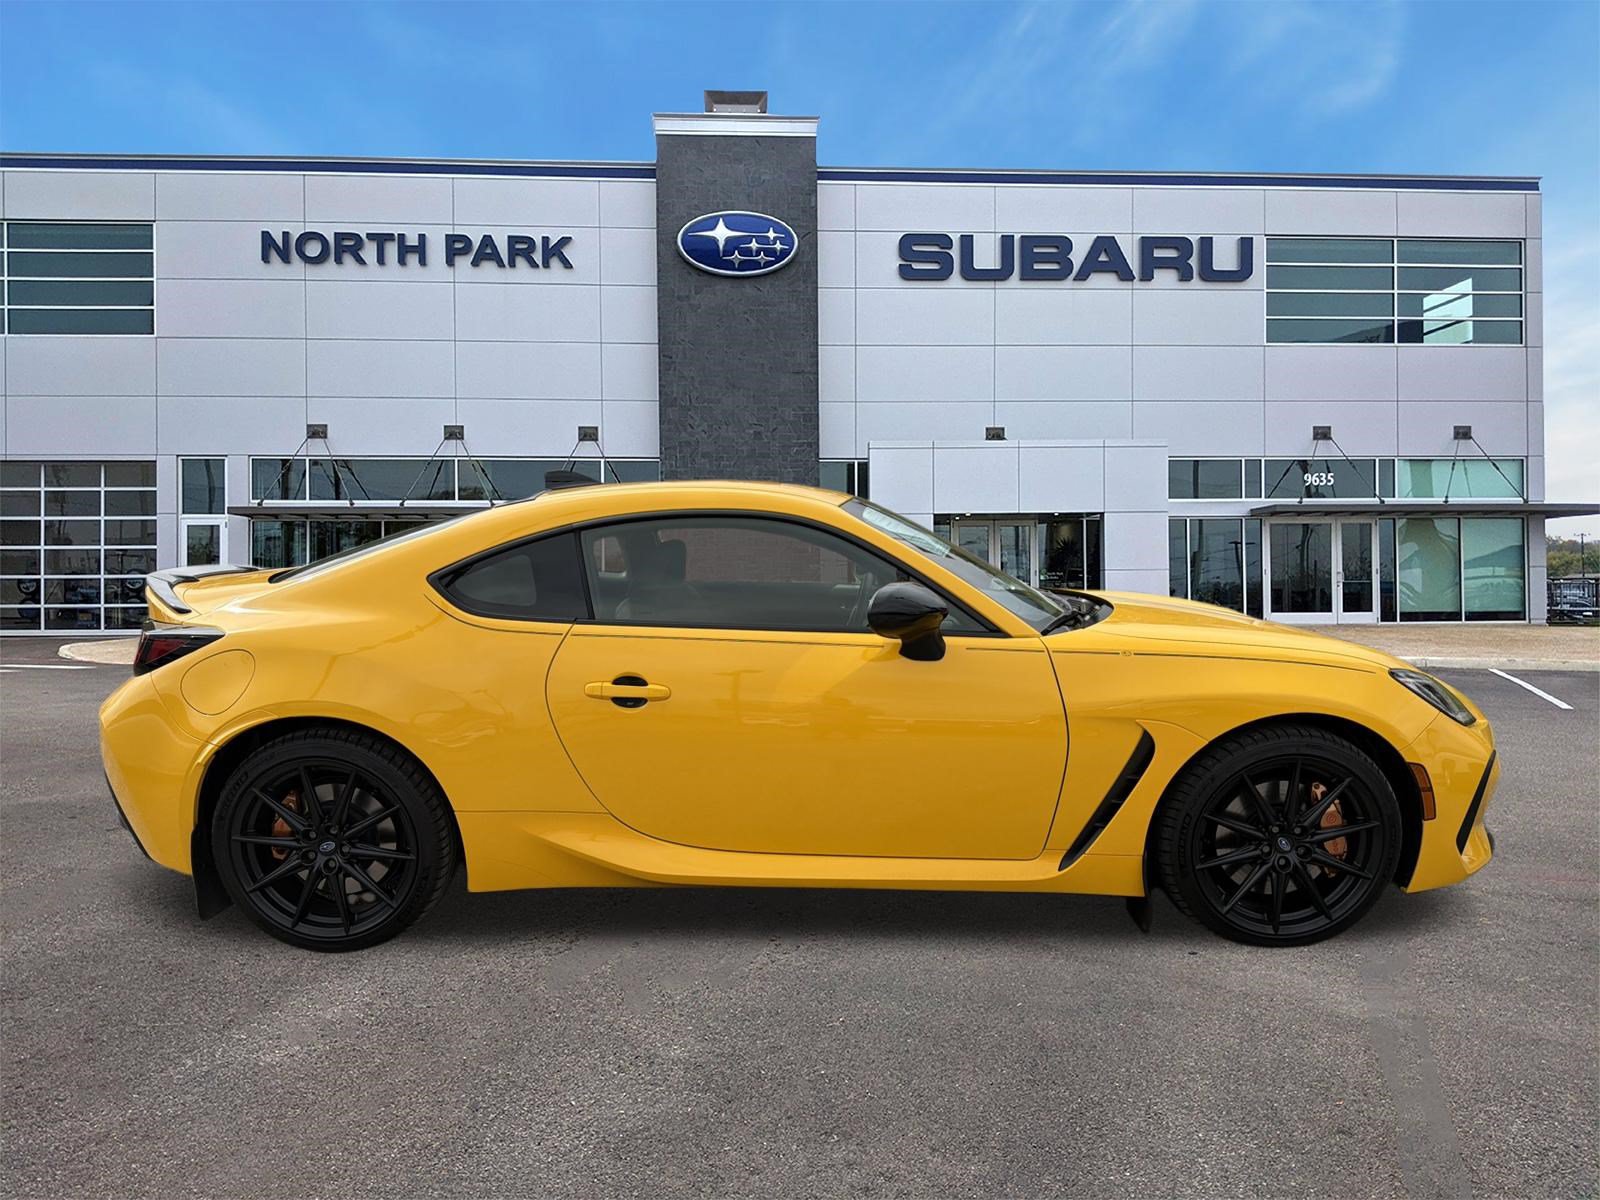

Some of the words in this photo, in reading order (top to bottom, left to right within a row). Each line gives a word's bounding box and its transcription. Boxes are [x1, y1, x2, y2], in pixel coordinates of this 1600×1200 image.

[260, 230, 427, 266] NORTH
[444, 234, 574, 270] PARK
[898, 233, 1253, 283] SUBARU
[1304, 472, 1335, 486] 9635
